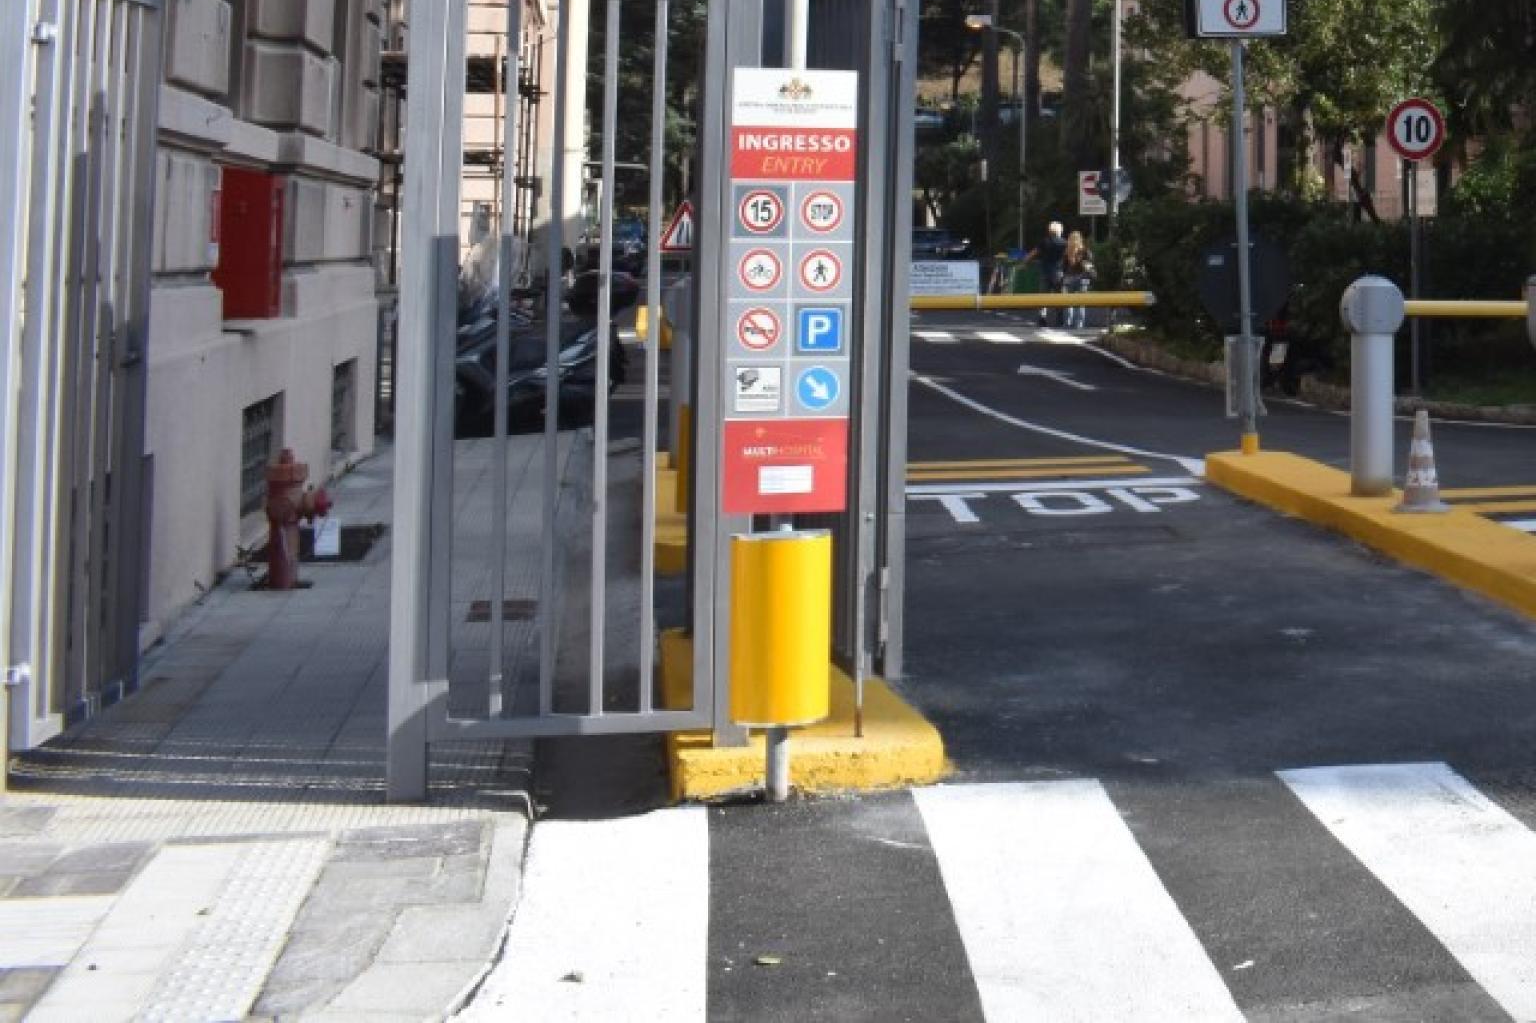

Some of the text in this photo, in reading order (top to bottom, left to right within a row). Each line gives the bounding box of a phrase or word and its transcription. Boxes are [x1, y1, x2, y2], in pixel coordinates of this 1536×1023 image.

[1403, 116, 1431, 143] 10
[738, 133, 851, 153] INGRESSO
[761, 156, 828, 175] ENTRY
[750, 199, 772, 222] 15
[808, 315, 831, 344] P
